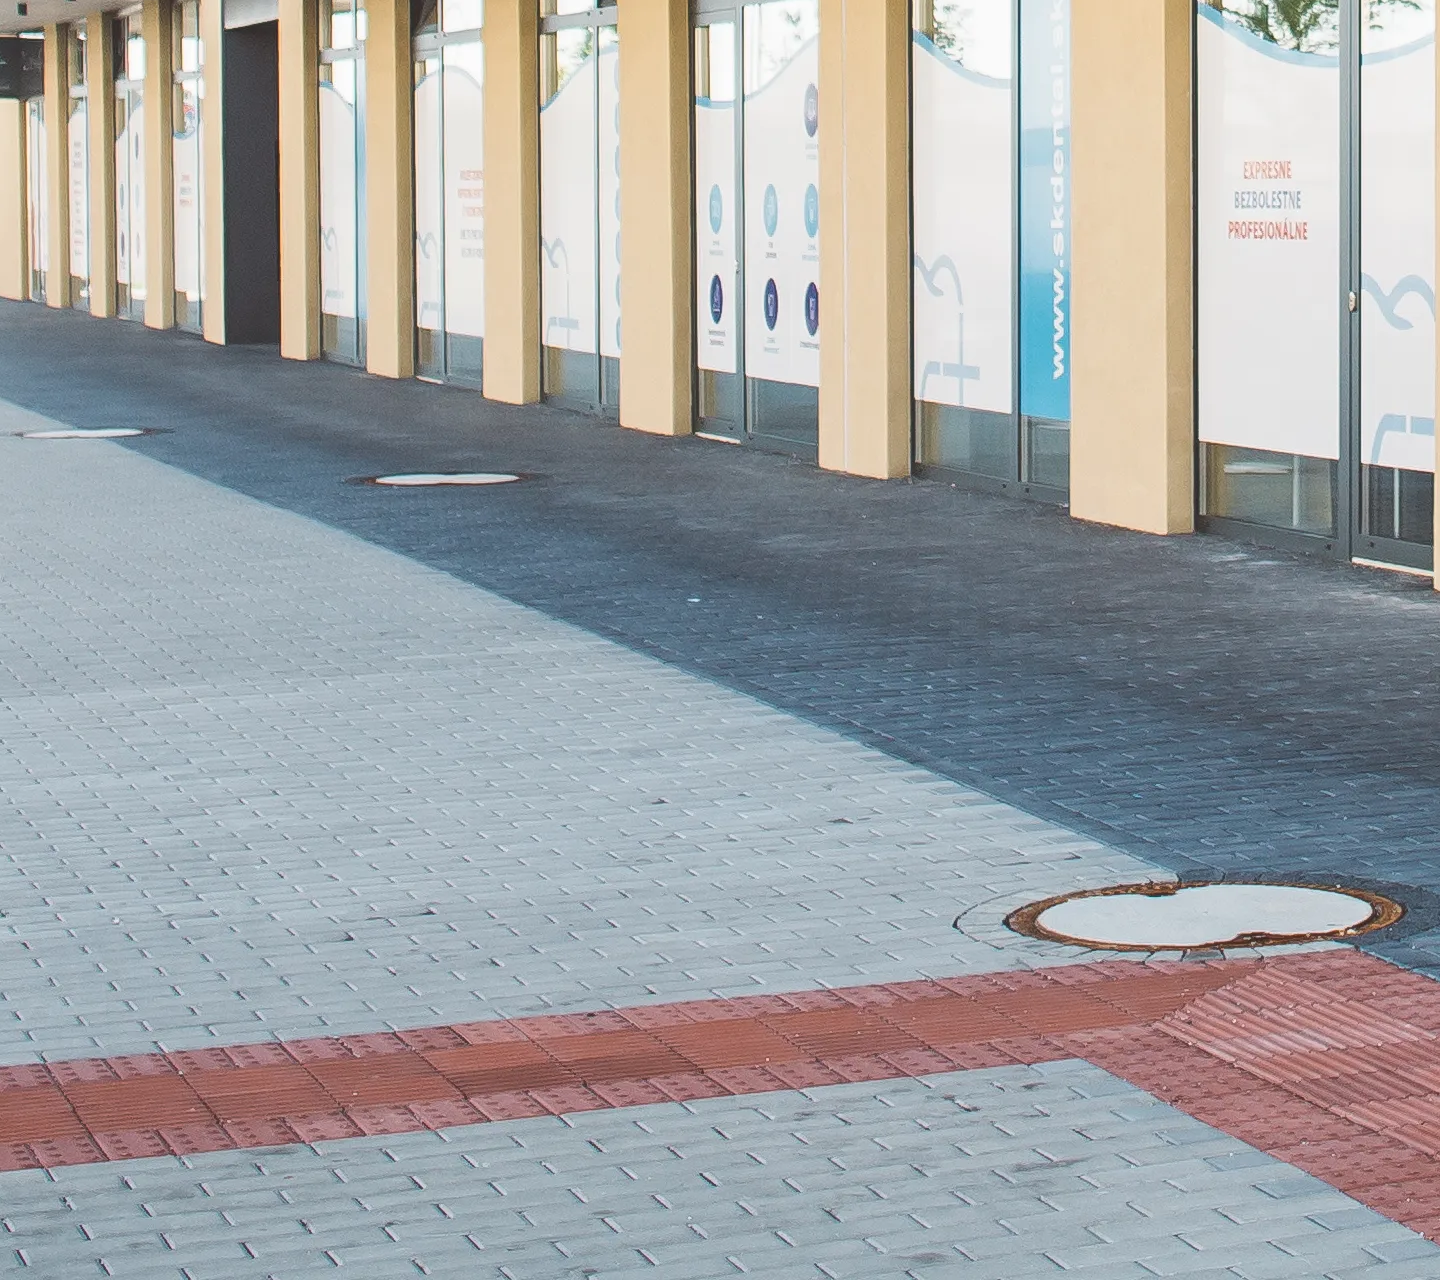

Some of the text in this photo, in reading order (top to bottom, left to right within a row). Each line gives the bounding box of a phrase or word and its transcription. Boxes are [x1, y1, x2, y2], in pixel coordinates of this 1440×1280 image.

[1243, 161, 1292, 179] EXPRESNE
[1234, 190, 1301, 209] BEZBOLESTNE
[1228, 217, 1308, 240] PROFESIONÁLNE
